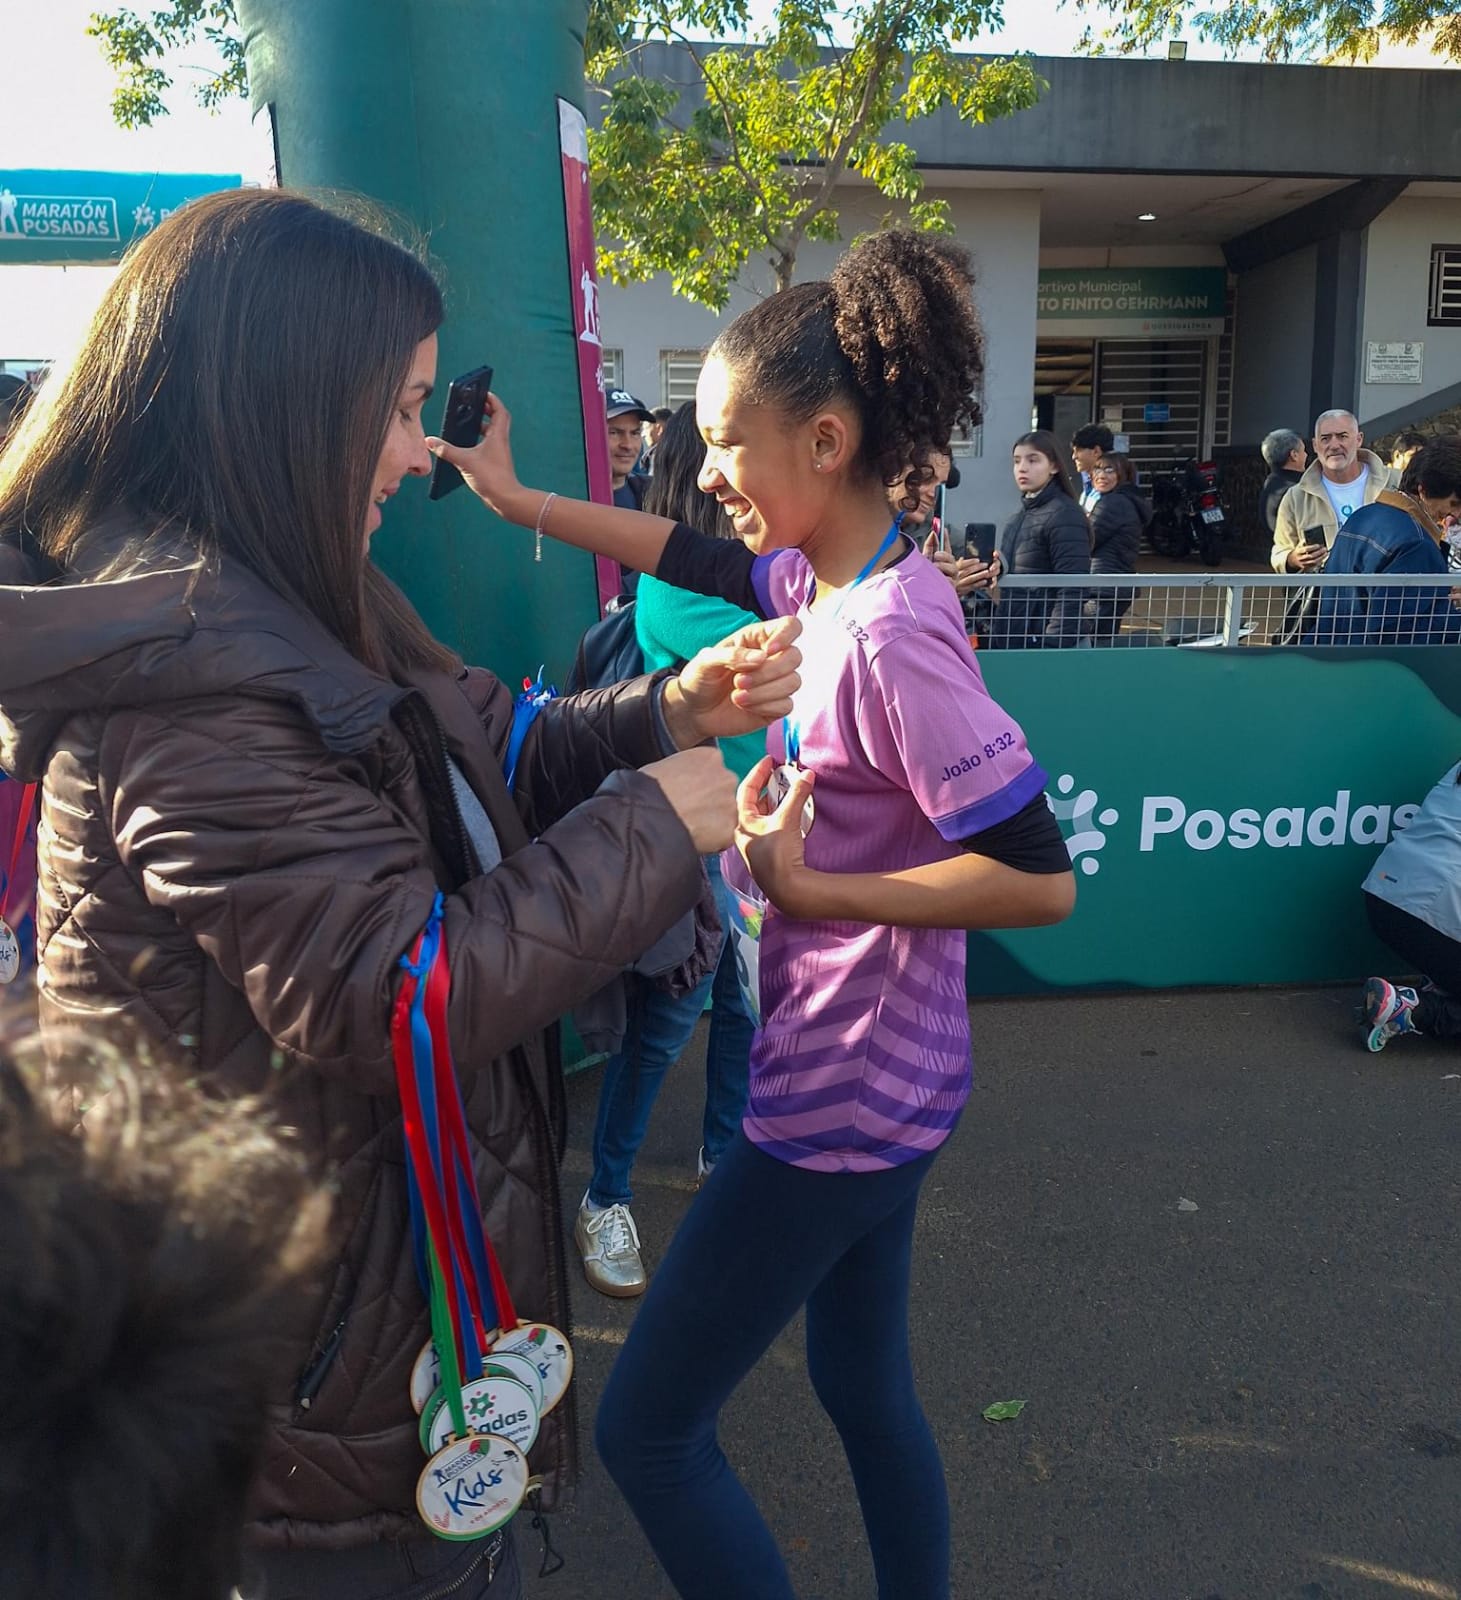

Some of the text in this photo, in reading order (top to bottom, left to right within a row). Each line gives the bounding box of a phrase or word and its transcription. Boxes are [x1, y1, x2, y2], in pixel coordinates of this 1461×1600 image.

[22, 200, 107, 218] MARATÓN
[23, 219, 110, 236] POSADAS
[1039, 280, 1142, 295] ortivo Municipal
[1039, 296, 1208, 311] TO FINITO GEHRMANN
[941, 732, 1016, 782] João 8:32
[444, 1468, 504, 1516] Kids
